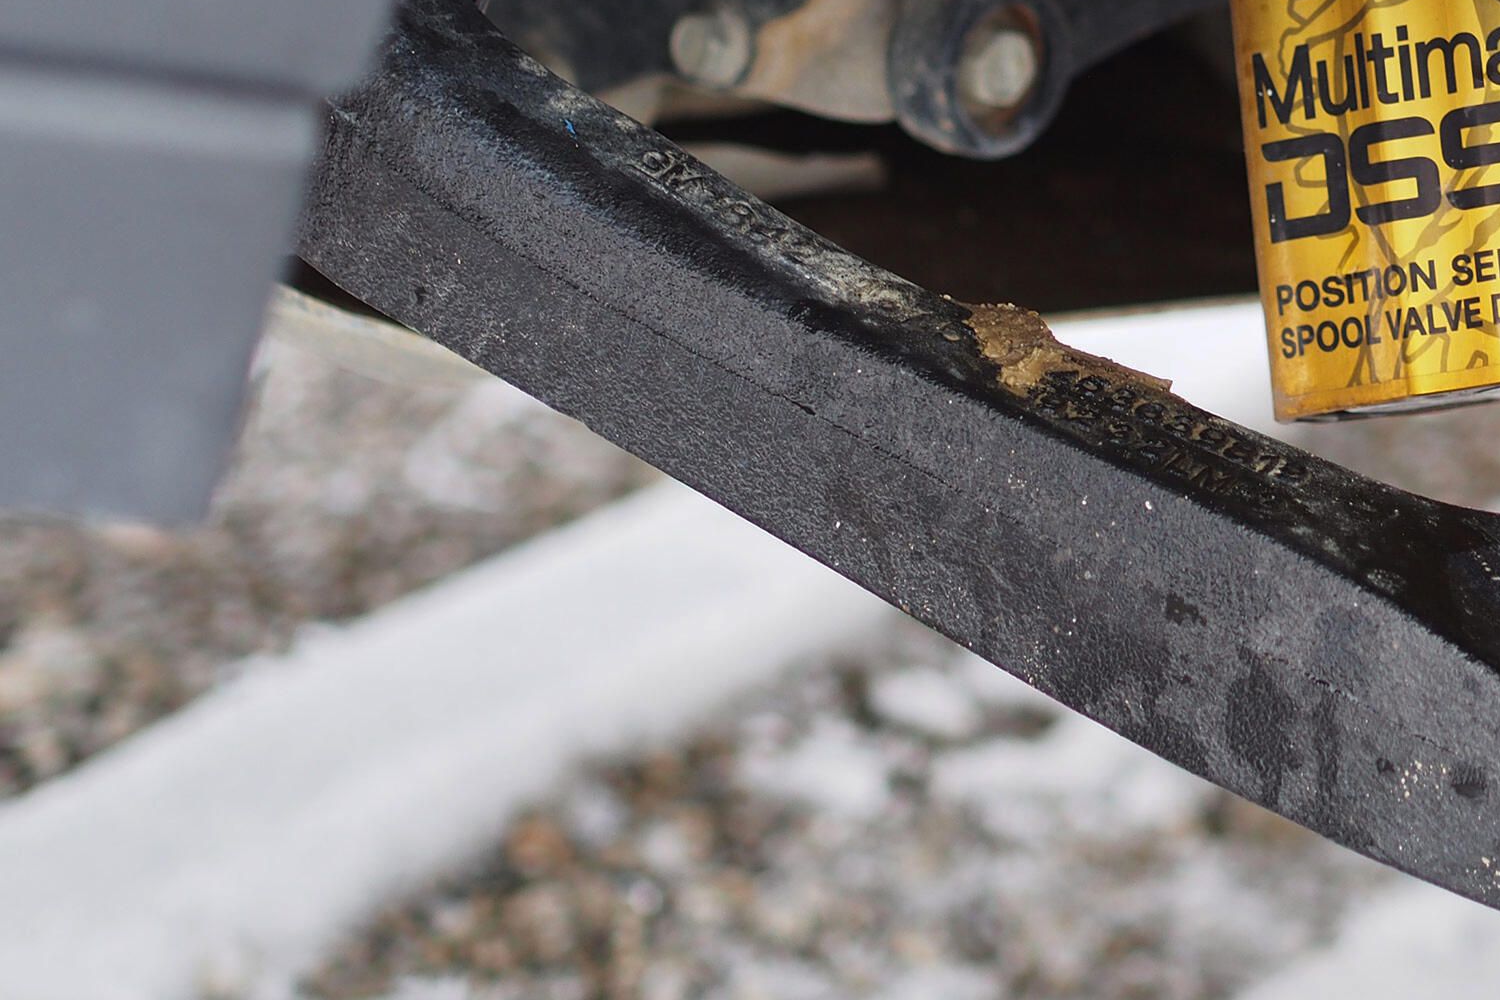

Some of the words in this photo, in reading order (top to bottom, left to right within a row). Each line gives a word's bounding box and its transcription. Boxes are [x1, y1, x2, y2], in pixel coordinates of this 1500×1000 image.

[1276, 260, 1437, 316] POSITION
[1281, 315, 1382, 359] SPOOL
[1386, 297, 1484, 341] VALVE
